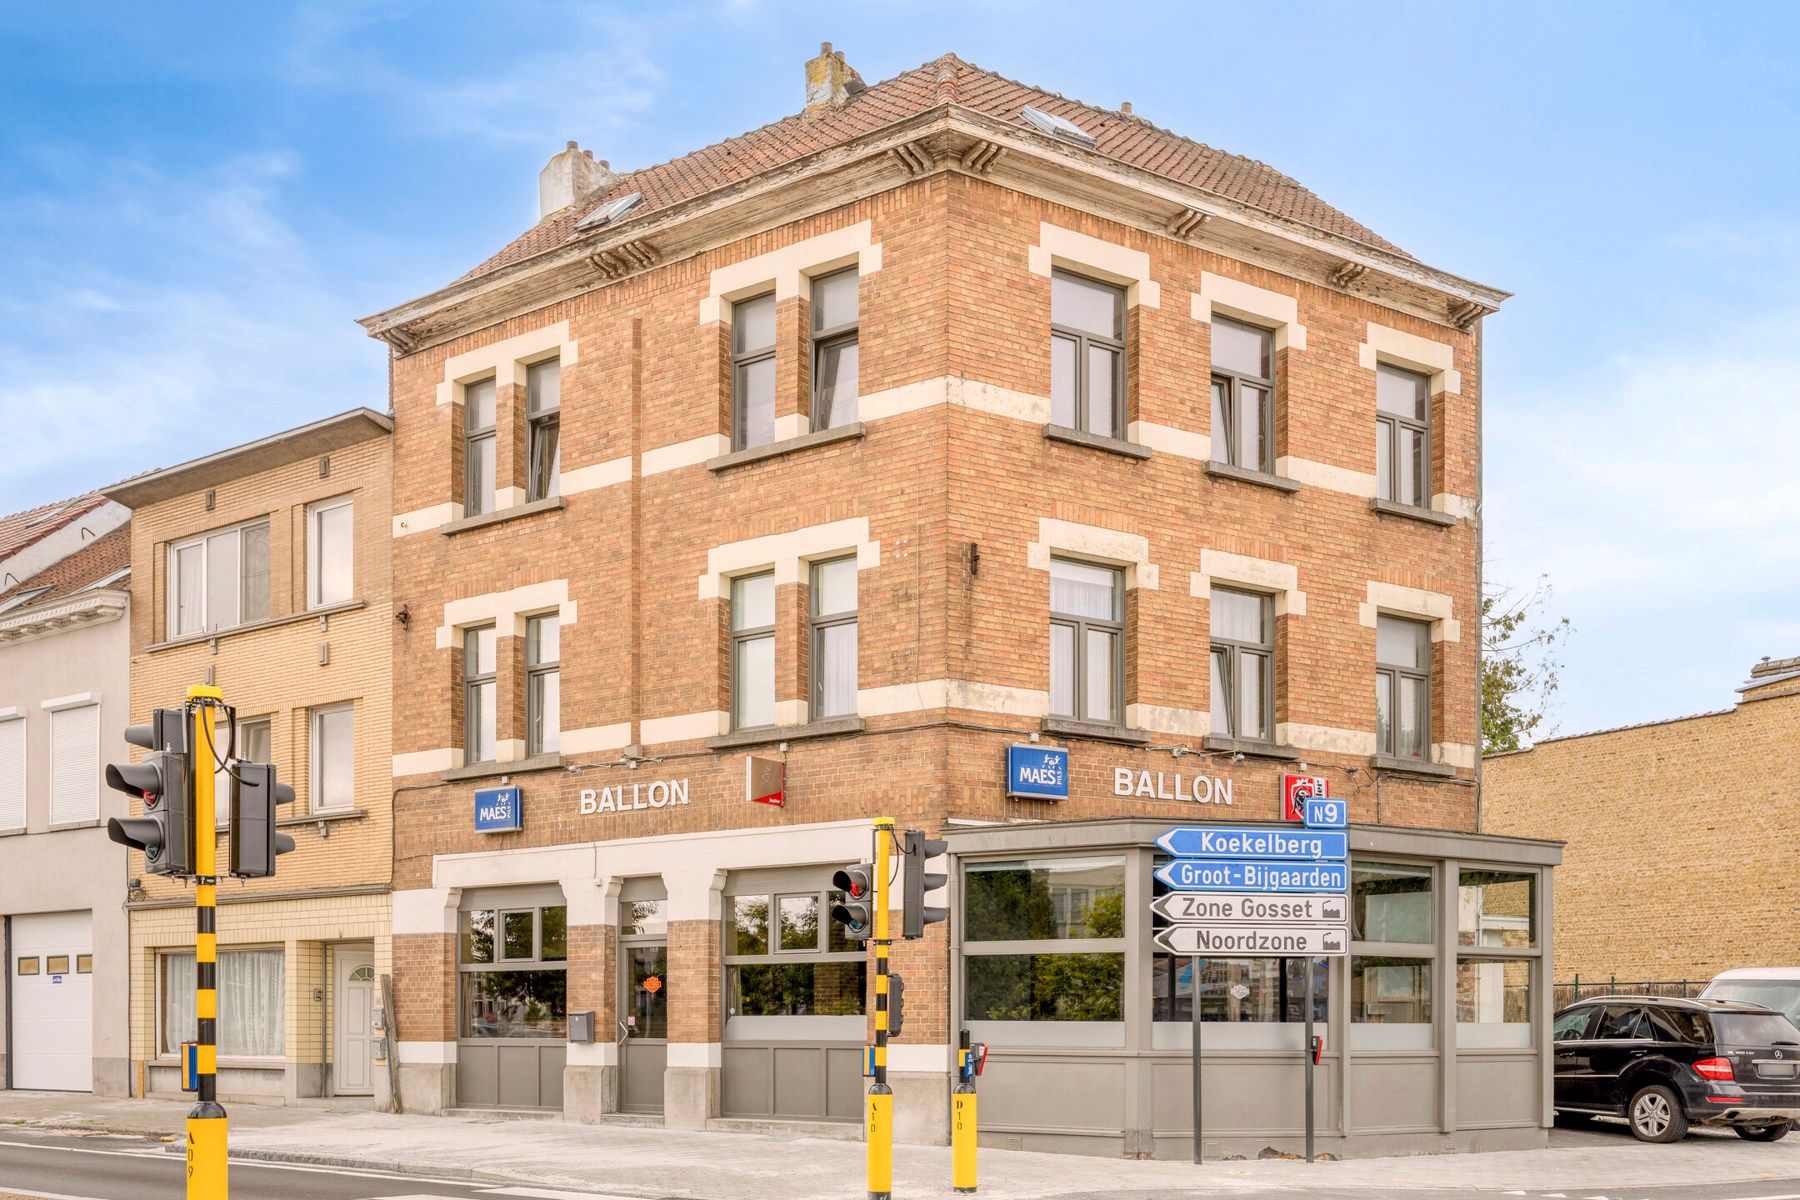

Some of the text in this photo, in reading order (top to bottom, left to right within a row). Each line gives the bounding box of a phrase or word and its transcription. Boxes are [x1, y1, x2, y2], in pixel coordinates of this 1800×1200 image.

[1019, 767, 1056, 785] MAES
[580, 778, 689, 814] BALLON
[1114, 768, 1232, 805] BALLON
[479, 806, 507, 821] MAES
[1314, 803, 1338, 823] N9
[1201, 832, 1322, 858] Koekelberg
[1181, 864, 1341, 890] Groot-Bijgaarden
[1182, 898, 1312, 918] Zone Gosset
[1196, 931, 1307, 950] Noordzone
